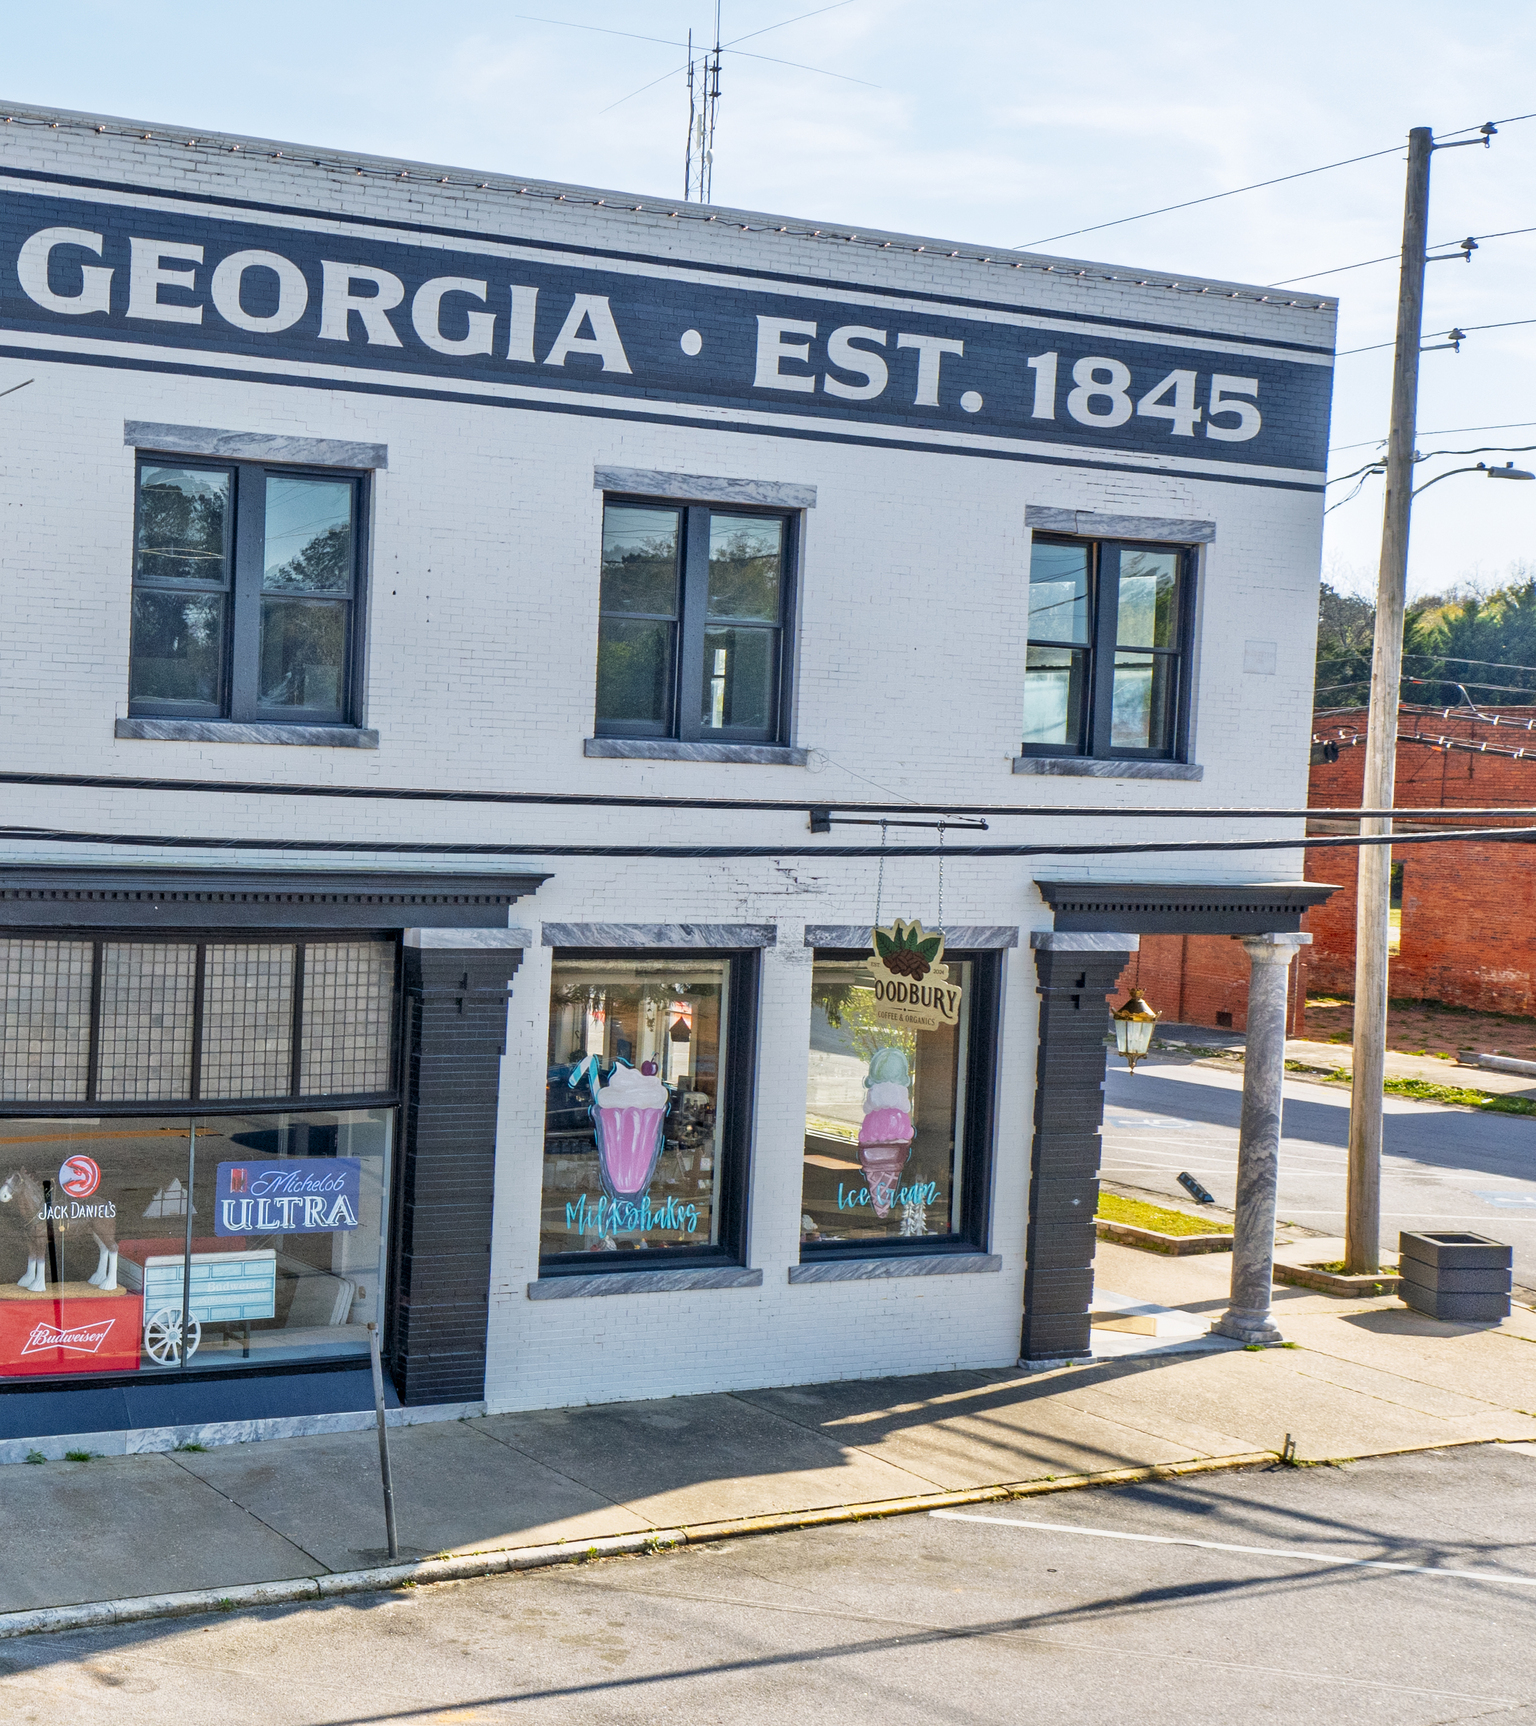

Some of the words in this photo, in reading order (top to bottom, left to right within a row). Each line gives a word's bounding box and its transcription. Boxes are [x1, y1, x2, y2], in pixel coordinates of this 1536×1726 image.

[16, 226, 633, 375] GEORGIA
[752, 315, 984, 413] EST.
[1027, 352, 1262, 442] 1845
[875, 980, 957, 1019] OODBURY
[877, 1011, 897, 1021] COFFEE
[899, 1013, 904, 1022] &
[905, 1015, 935, 1026] ORGANICS
[251, 1170, 347, 1196] Michelob
[838, 1182, 871, 1210] Ice
[876, 1181, 942, 1209] Cream
[38, 1203, 68, 1220] JACK
[70, 1201, 116, 1218] DANIEL'S
[221, 1194, 358, 1231] ULTRA
[207, 1280, 267, 1292] Budweiser
[30, 1329, 105, 1346] Budweiser
